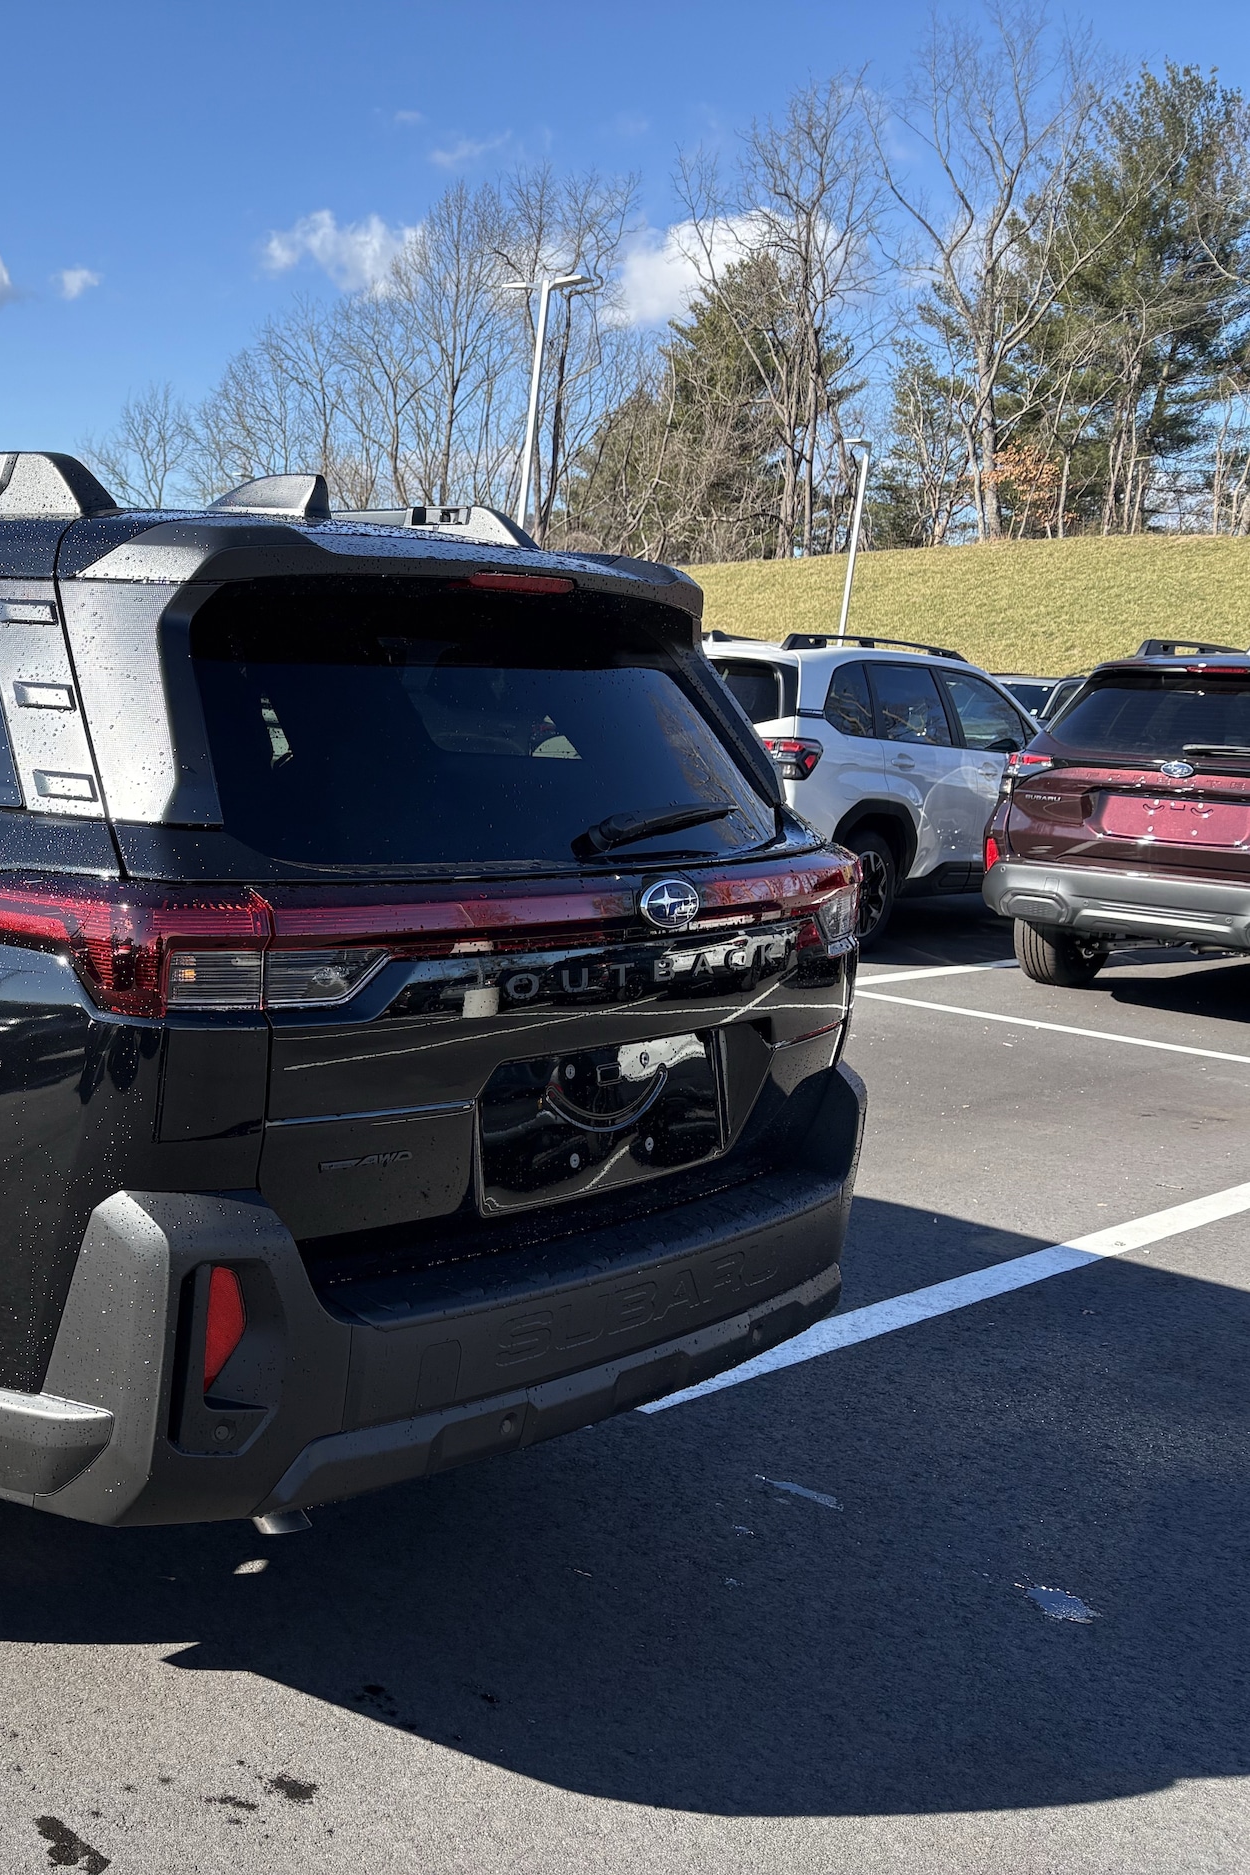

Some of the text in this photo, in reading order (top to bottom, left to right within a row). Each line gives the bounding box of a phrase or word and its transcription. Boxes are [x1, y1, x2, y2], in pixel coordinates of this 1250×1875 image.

[1024, 791, 1062, 803] SUBARU
[505, 941, 779, 1000] OUTBACK
[494, 1234, 784, 1368] SUBARU
